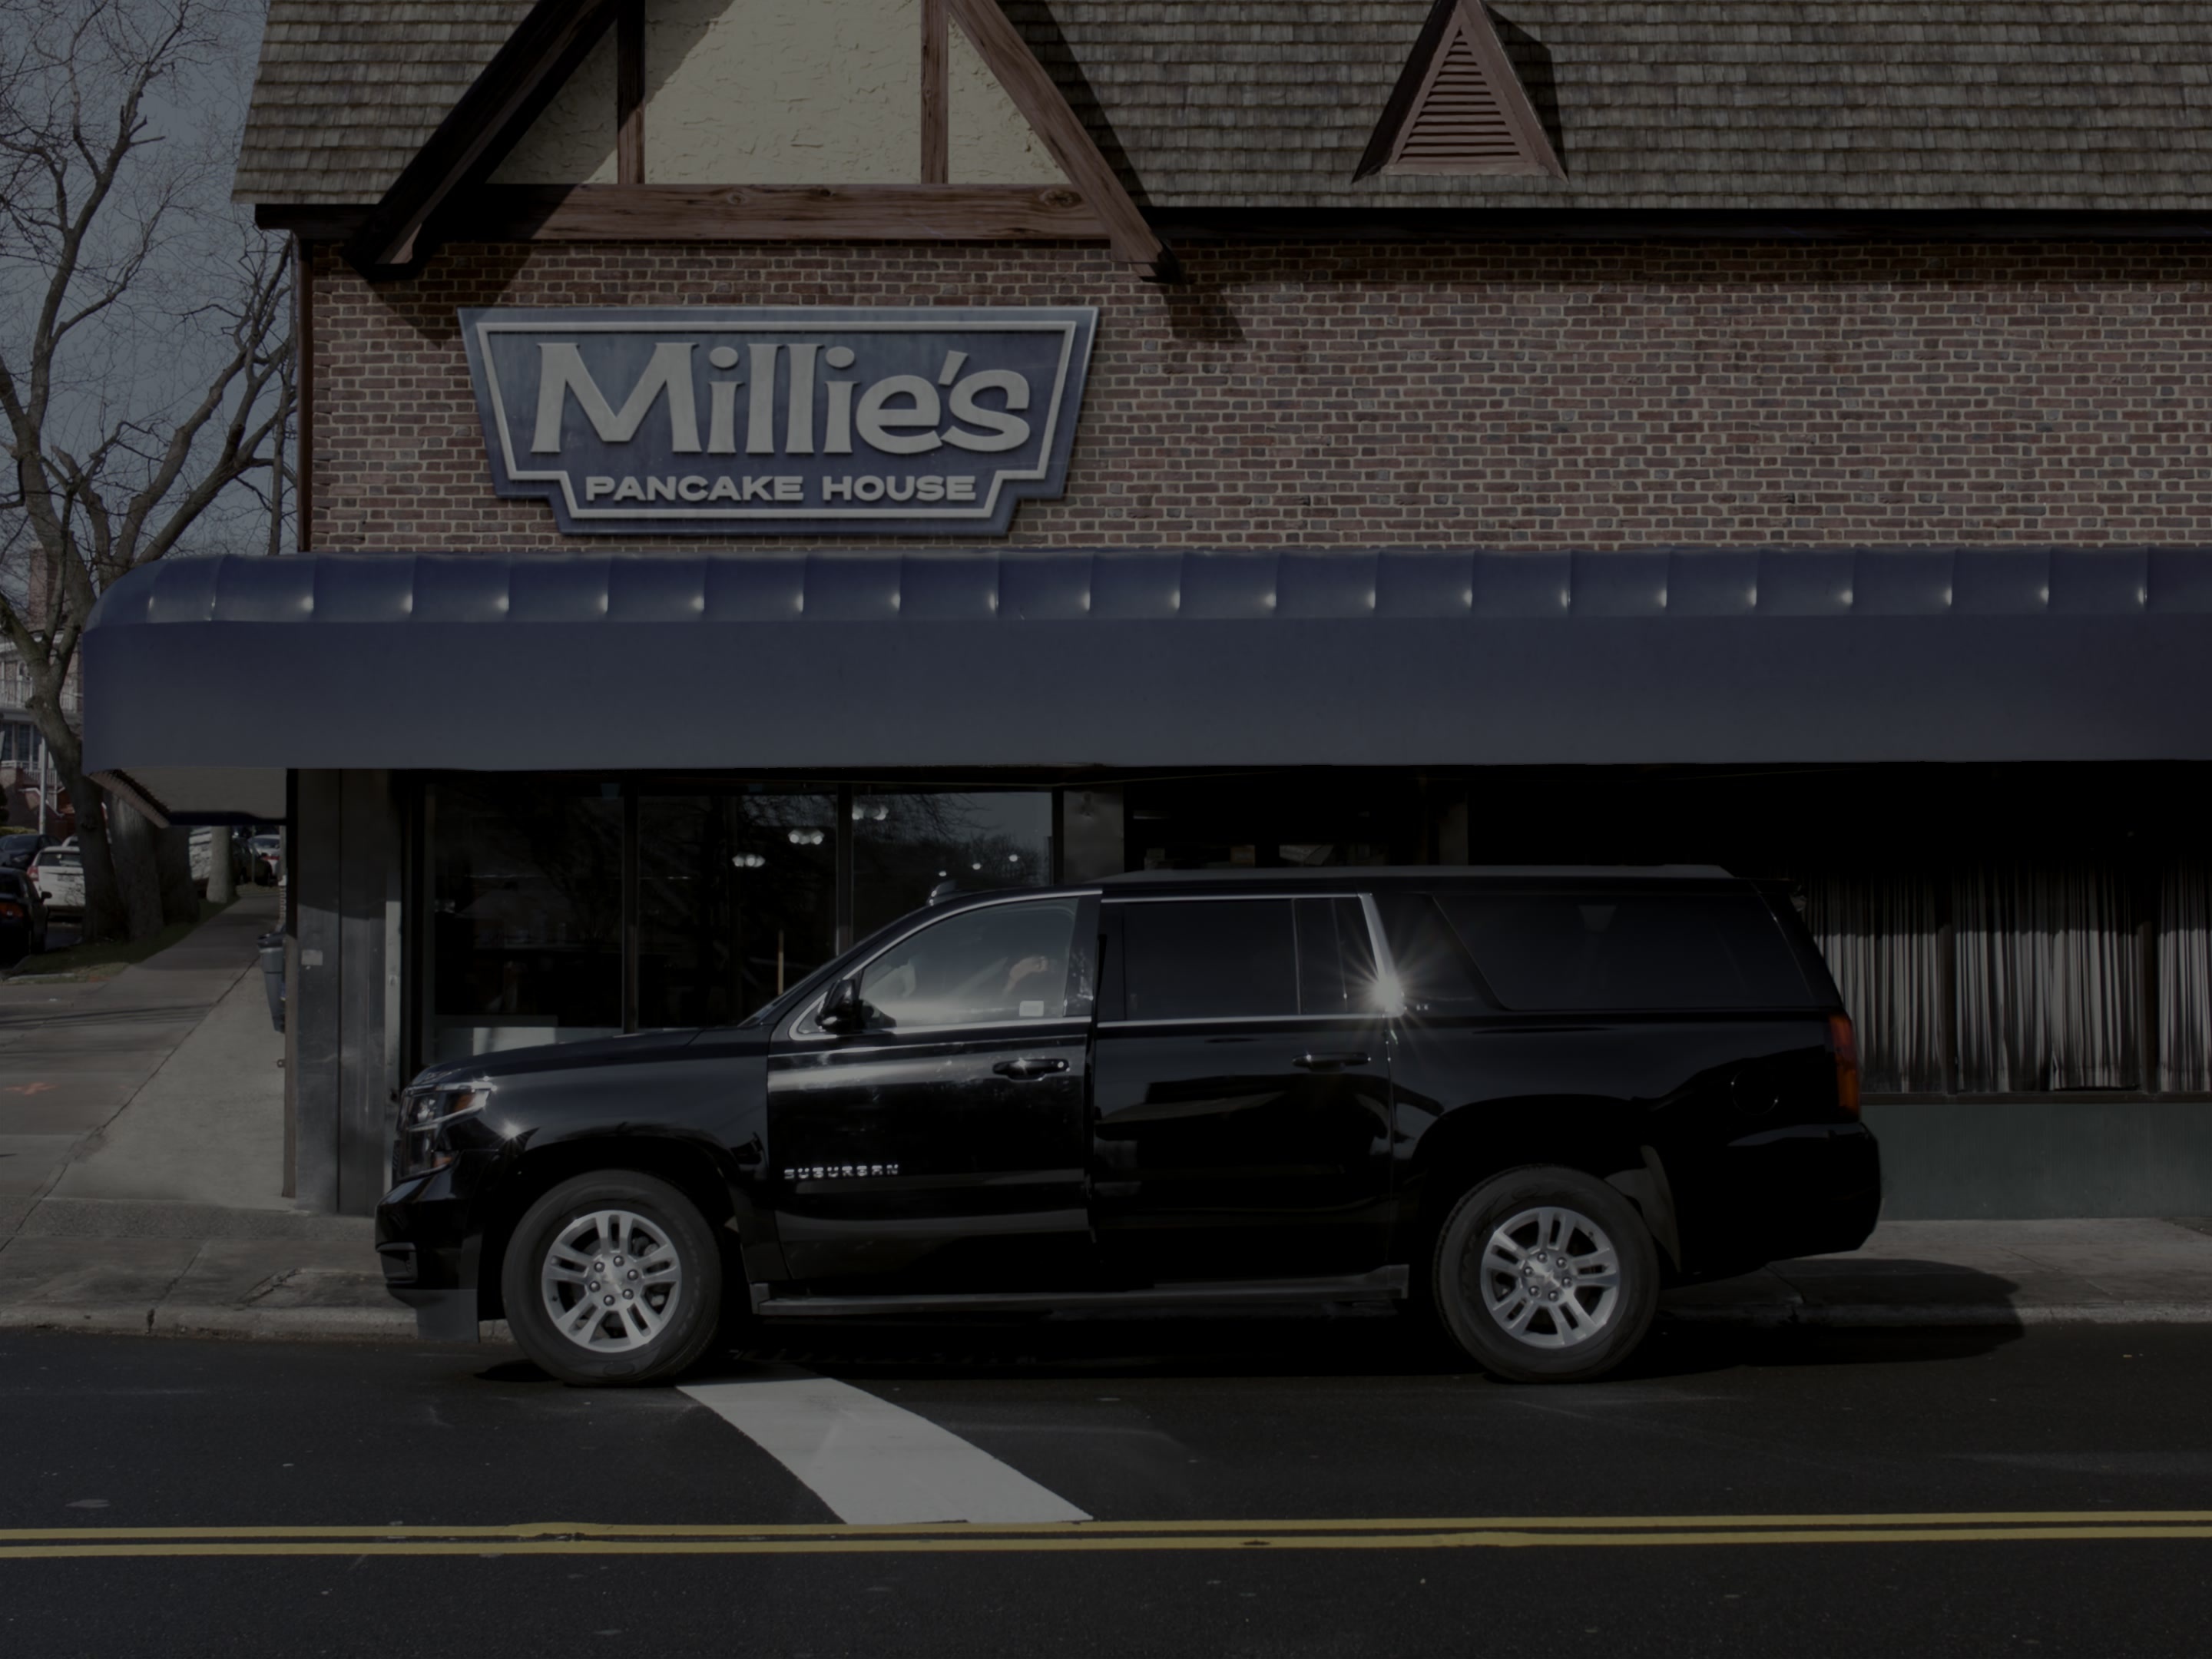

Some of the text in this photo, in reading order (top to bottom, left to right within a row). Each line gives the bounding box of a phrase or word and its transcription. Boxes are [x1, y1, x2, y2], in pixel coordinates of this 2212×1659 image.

[531, 341, 1031, 455] Millie's
[585, 475, 977, 502] PANCAKE HOUSE
[783, 1163, 899, 1181] SUBURBAN
